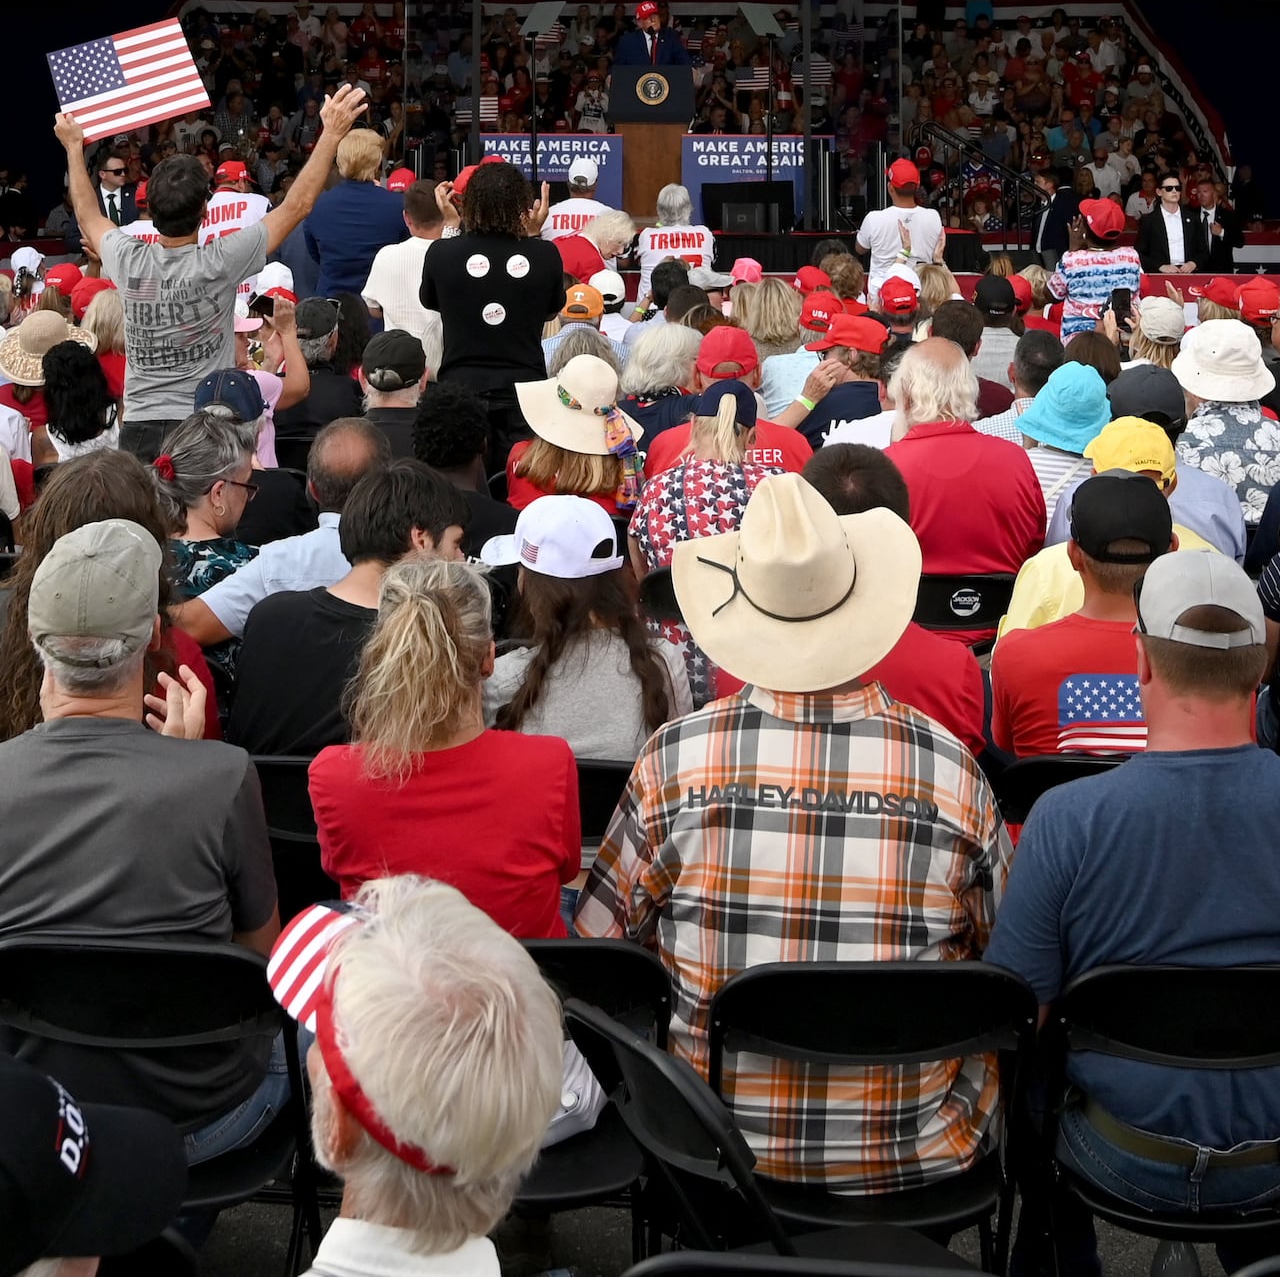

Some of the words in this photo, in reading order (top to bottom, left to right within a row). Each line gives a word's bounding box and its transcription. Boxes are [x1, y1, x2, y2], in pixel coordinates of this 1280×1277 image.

[484, 140, 530, 152] MAKE
[536, 140, 611, 152] AMERICA
[692, 141, 738, 153] MAKE
[492, 154, 543, 165] REAT
[698, 155, 751, 166] GREAT
[202, 202, 247, 229] RUMP
[650, 233, 705, 250] TRUMP
[161, 278, 192, 290] GREAT
[160, 290, 188, 301] LAND
[195, 284, 208, 296] OF
[125, 293, 220, 326] LIBERTY
[812, 310, 828, 319] USA
[126, 328, 155, 339] GREAT
[687, 783, 939, 824] HARLEY-DAVIDSON
